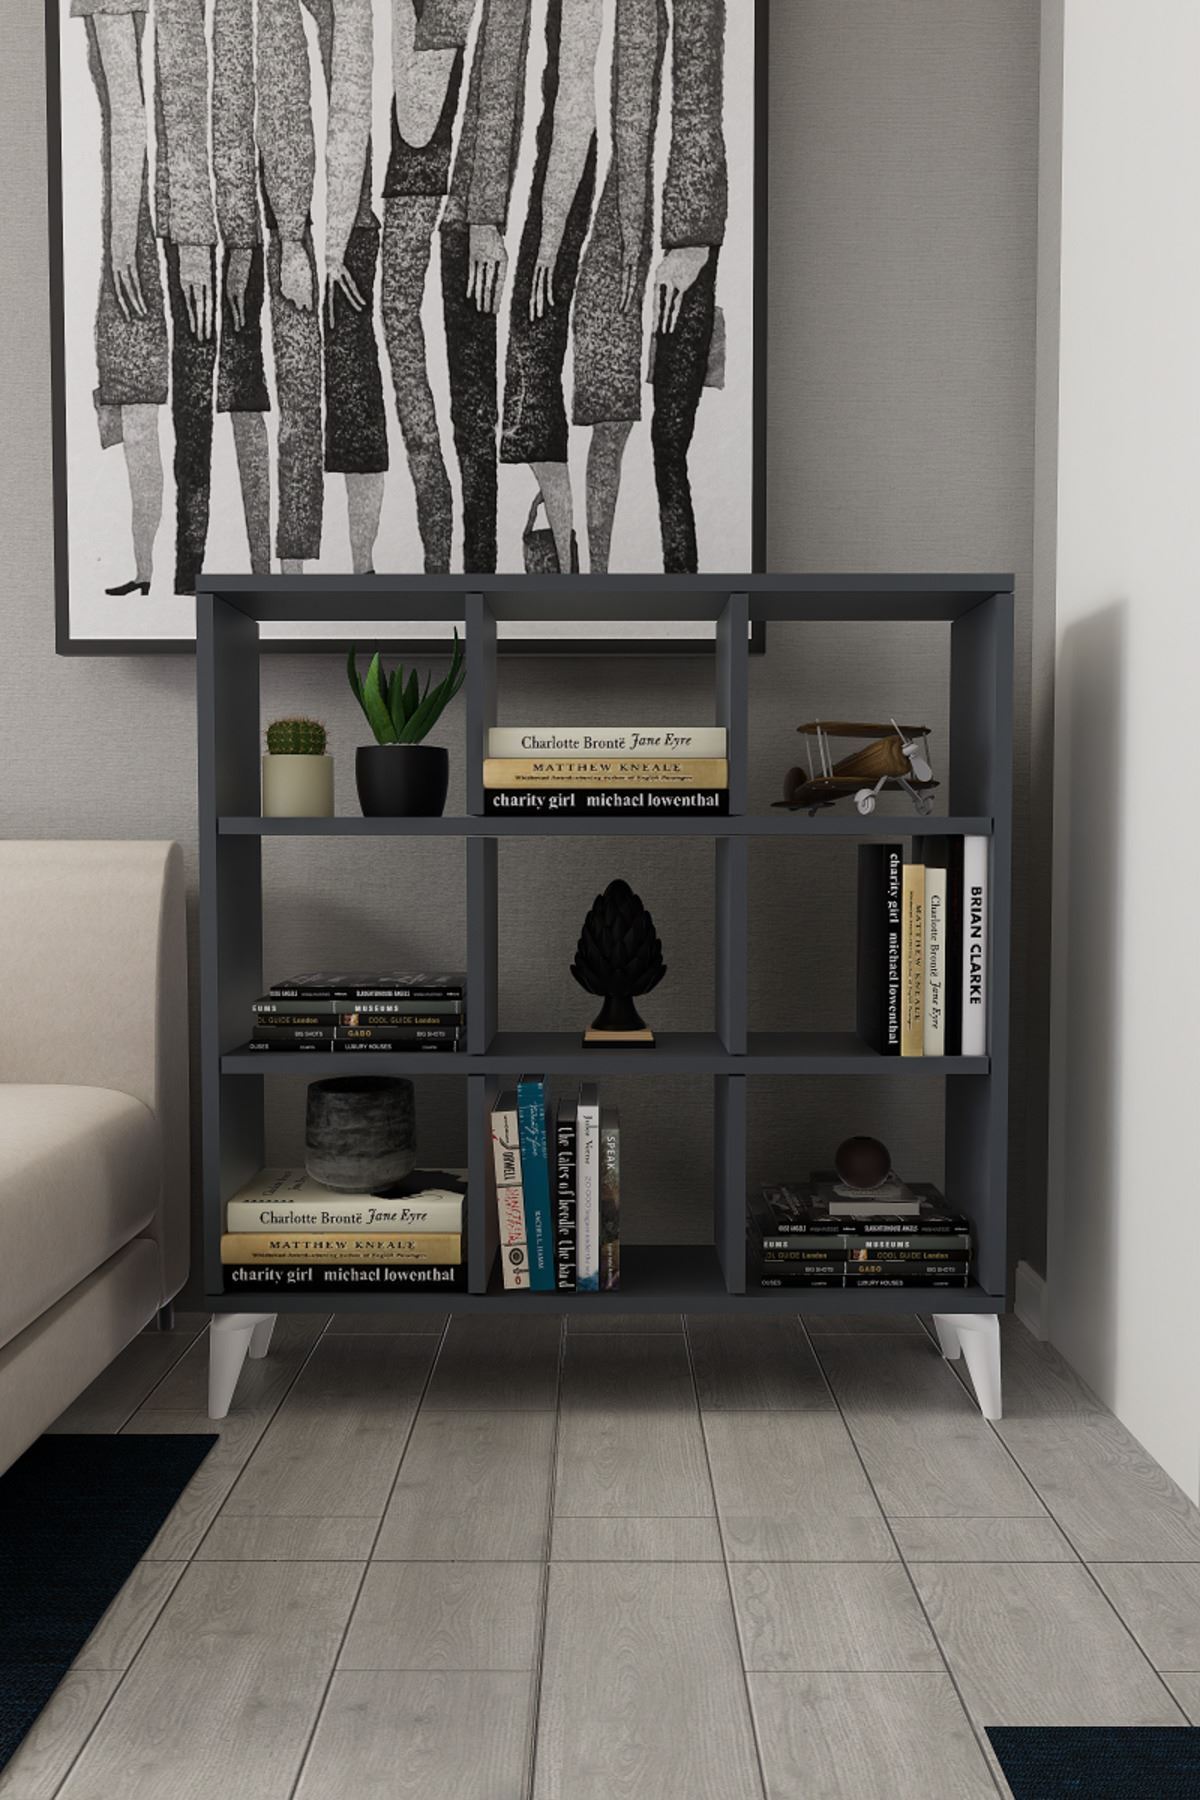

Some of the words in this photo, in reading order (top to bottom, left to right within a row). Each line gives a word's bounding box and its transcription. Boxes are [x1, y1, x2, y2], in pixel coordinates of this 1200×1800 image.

[521, 735, 580, 750] Charlotte
[583, 736, 626, 750] Brontë
[629, 732, 662, 750] Jane
[664, 733, 692, 750] Eyre
[533, 763, 613, 772] MATTHEW
[619, 763, 682, 772] KNEALE
[493, 793, 546, 810] charity
[548, 793, 576, 809] girl
[586, 793, 647, 807] michael
[647, 793, 720, 807] lowenthal
[888, 853, 900, 897] charity
[888, 900, 900, 924] girl
[930, 894, 941, 942] Charlotte
[970, 886, 982, 939] BRIAN
[914, 903, 922, 968] MATTHEW
[889, 932, 900, 980] michael
[929, 944, 940, 978] Brontë
[969, 944, 982, 1005] CLARKE
[929, 979, 942, 1005] Jane
[292, 1016, 318, 1024] London
[414, 1016, 440, 1024] London
[888, 982, 900, 1044] lowenthal
[929, 1006, 942, 1029] Eyre
[558, 1126, 575, 1146] the
[584, 1140, 593, 1165] Verne
[606, 1136, 616, 1170] SPEAK
[503, 1151, 515, 1181] ORWELL
[558, 1151, 575, 1180] tales
[558, 1182, 575, 1197] of
[260, 1211, 318, 1225] Charlotte
[321, 1212, 362, 1225] Brontë
[365, 1208, 397, 1225] Jane
[399, 1208, 428, 1224] Eyre
[558, 1199, 575, 1236] beedle
[269, 1240, 348, 1249] MATTHEW
[355, 1240, 416, 1249] KNEALE
[558, 1239, 575, 1260] the
[232, 1267, 284, 1284] charity
[286, 1267, 313, 1283] girl
[324, 1267, 381, 1281] michael
[383, 1267, 455, 1281] lowenthal
